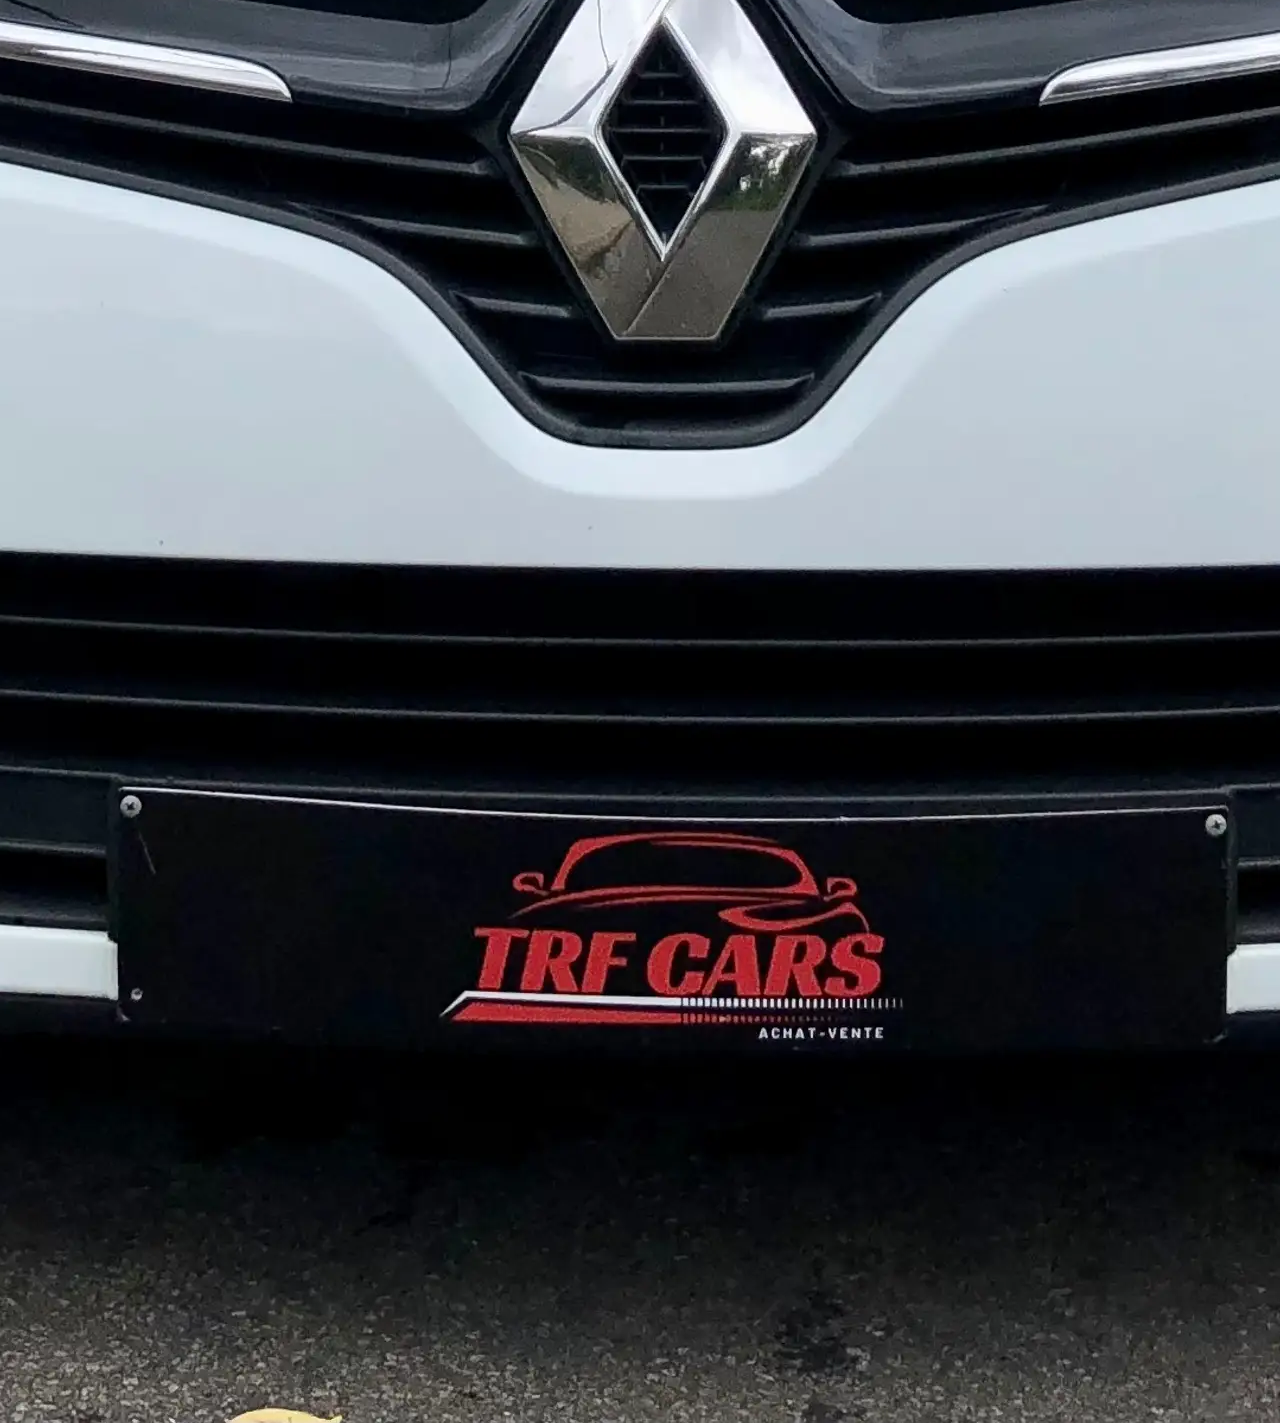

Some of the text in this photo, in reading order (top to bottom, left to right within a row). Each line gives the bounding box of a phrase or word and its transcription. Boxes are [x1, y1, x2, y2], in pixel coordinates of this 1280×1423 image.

[474, 927, 885, 996] TRF CARS
[758, 1026, 884, 1040] ACHAT-VENTE
